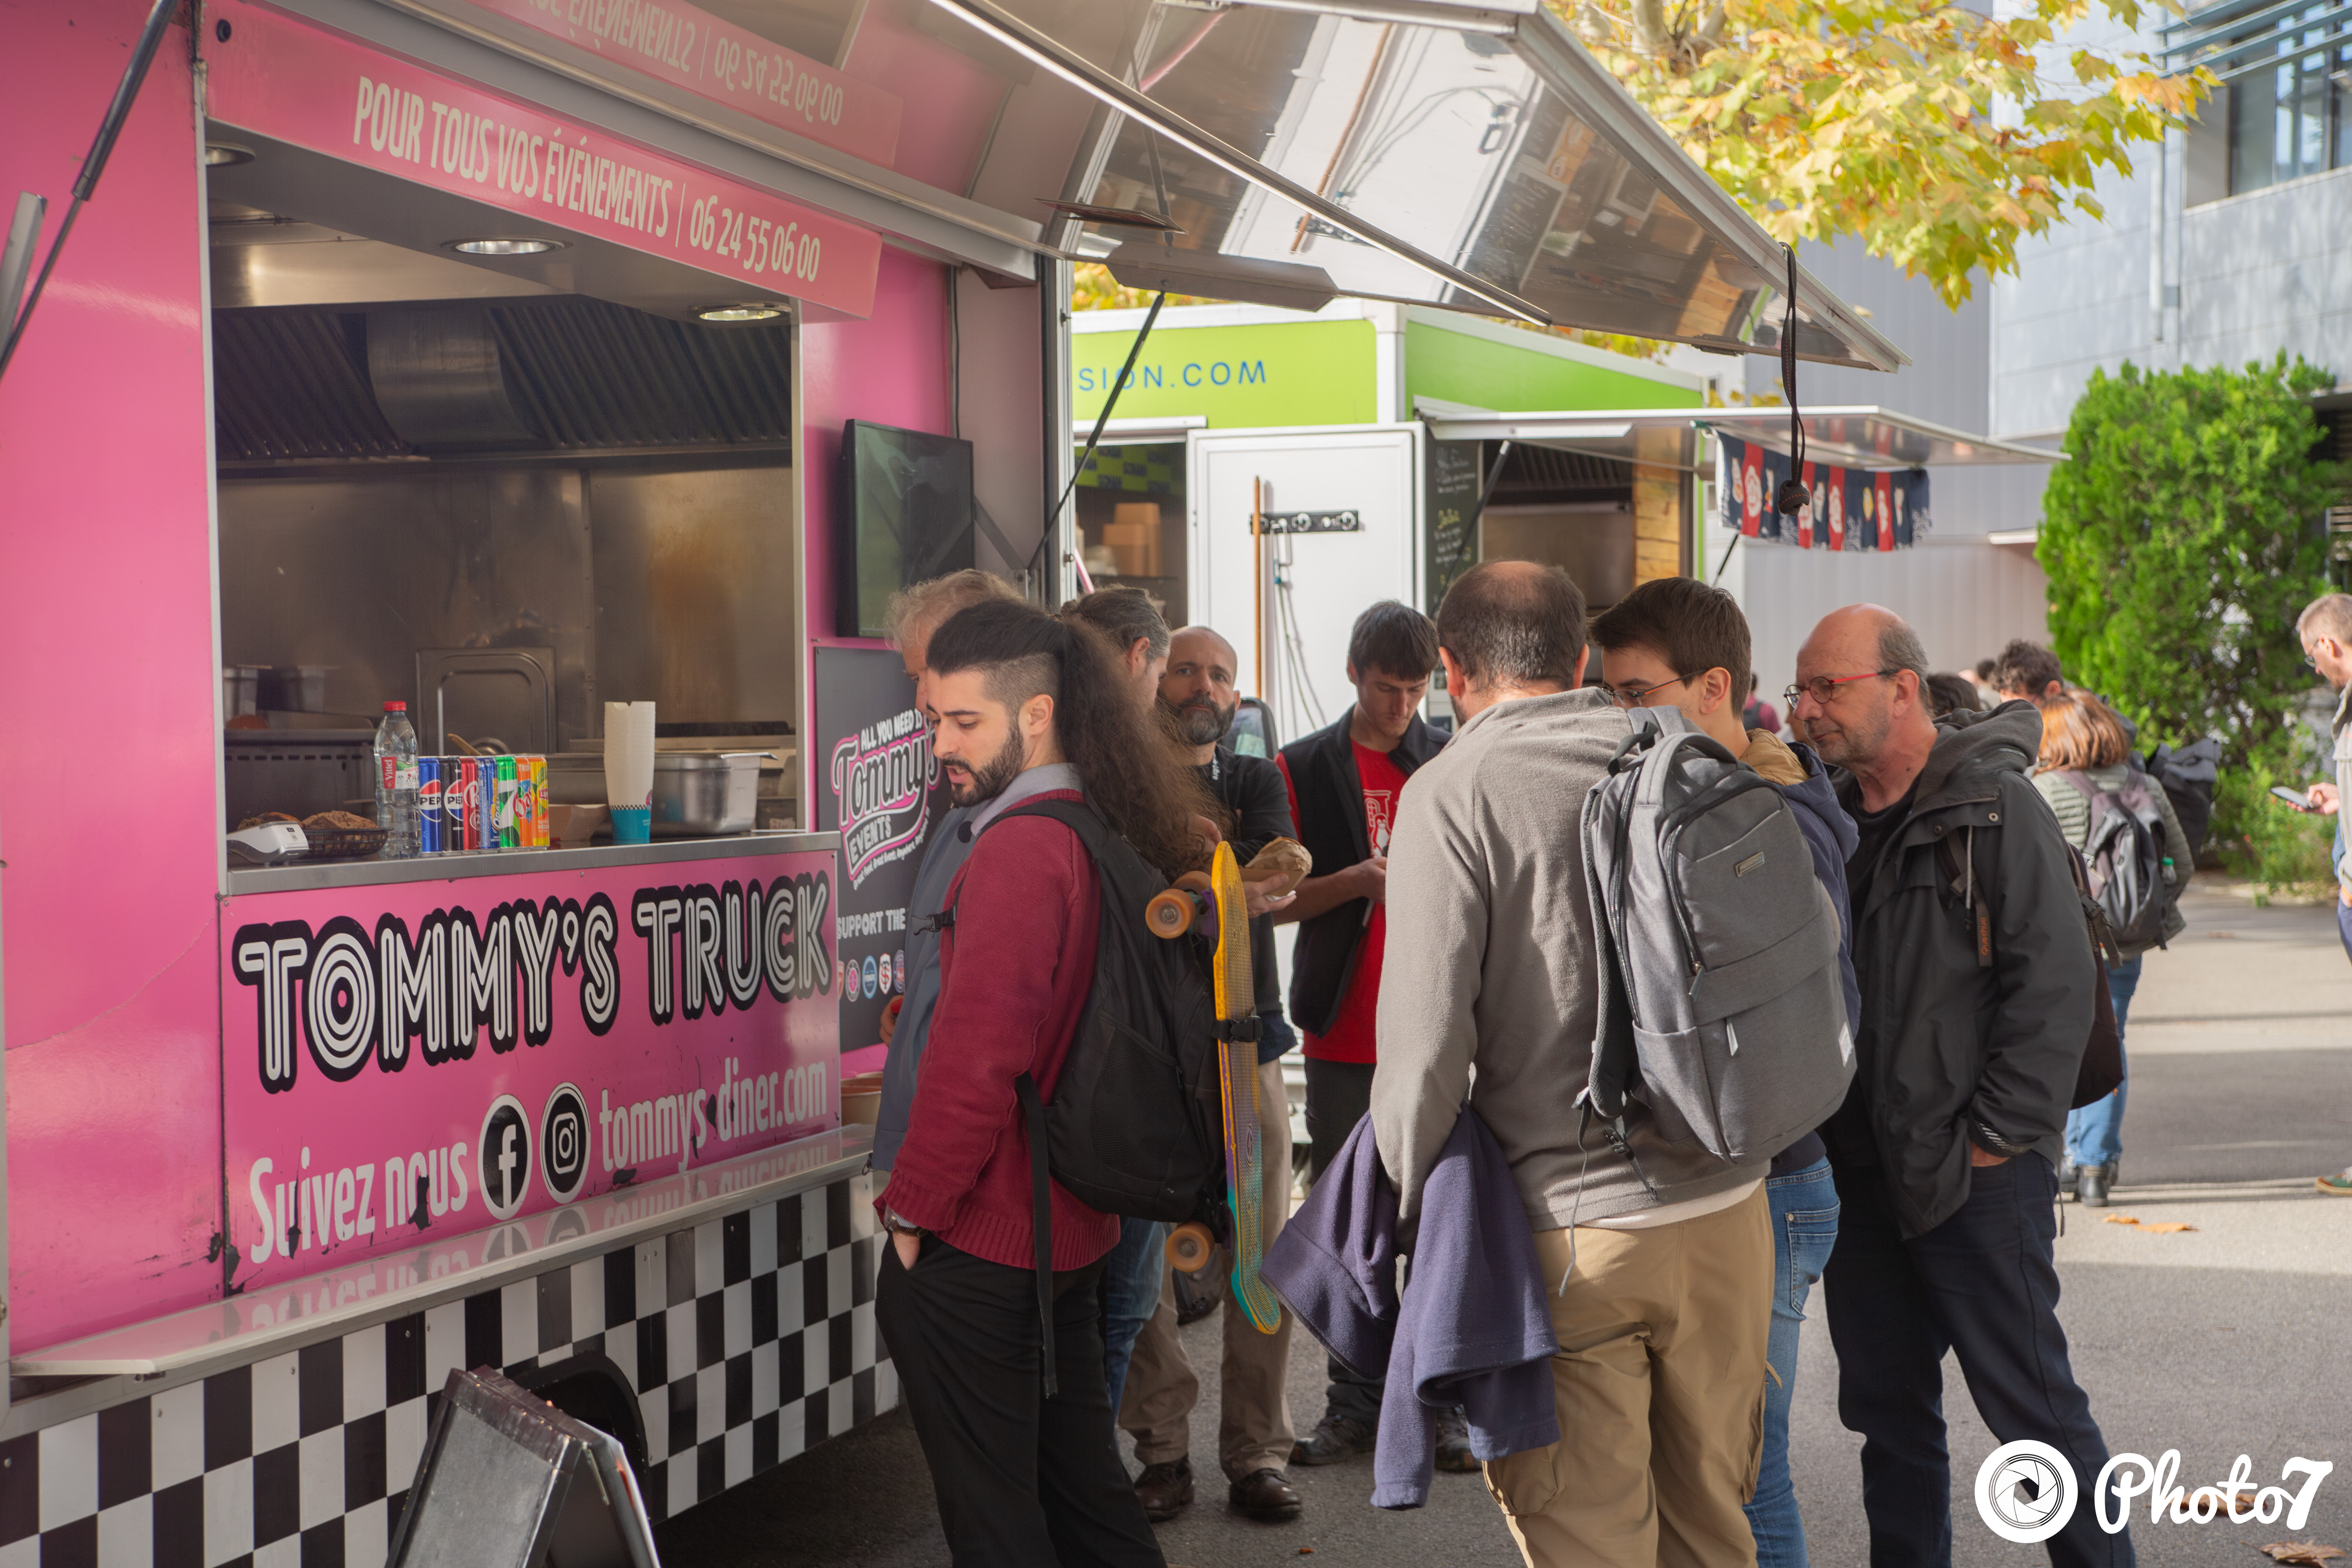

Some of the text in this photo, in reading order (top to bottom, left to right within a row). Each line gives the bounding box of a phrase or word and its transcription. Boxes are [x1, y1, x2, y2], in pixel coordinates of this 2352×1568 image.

[353, 76, 821, 282] POUR TOUS VOS ÉVÉNEMENTS 06 24 55 06 00
[861, 726, 877, 752] ALL
[876, 718, 893, 746] YOU
[893, 709, 915, 737] NEED
[384, 759, 393, 781] Vittel
[420, 797, 440, 805] PEP
[849, 815, 892, 865] EVENTS
[837, 908, 906, 940] SUPPORT THE
[1980, 917, 1989, 956] Quechua
[232, 870, 832, 1094] TOMMY'S TRUCK
[250, 1146, 375, 1264] Suivez
[385, 1142, 468, 1228] nous
